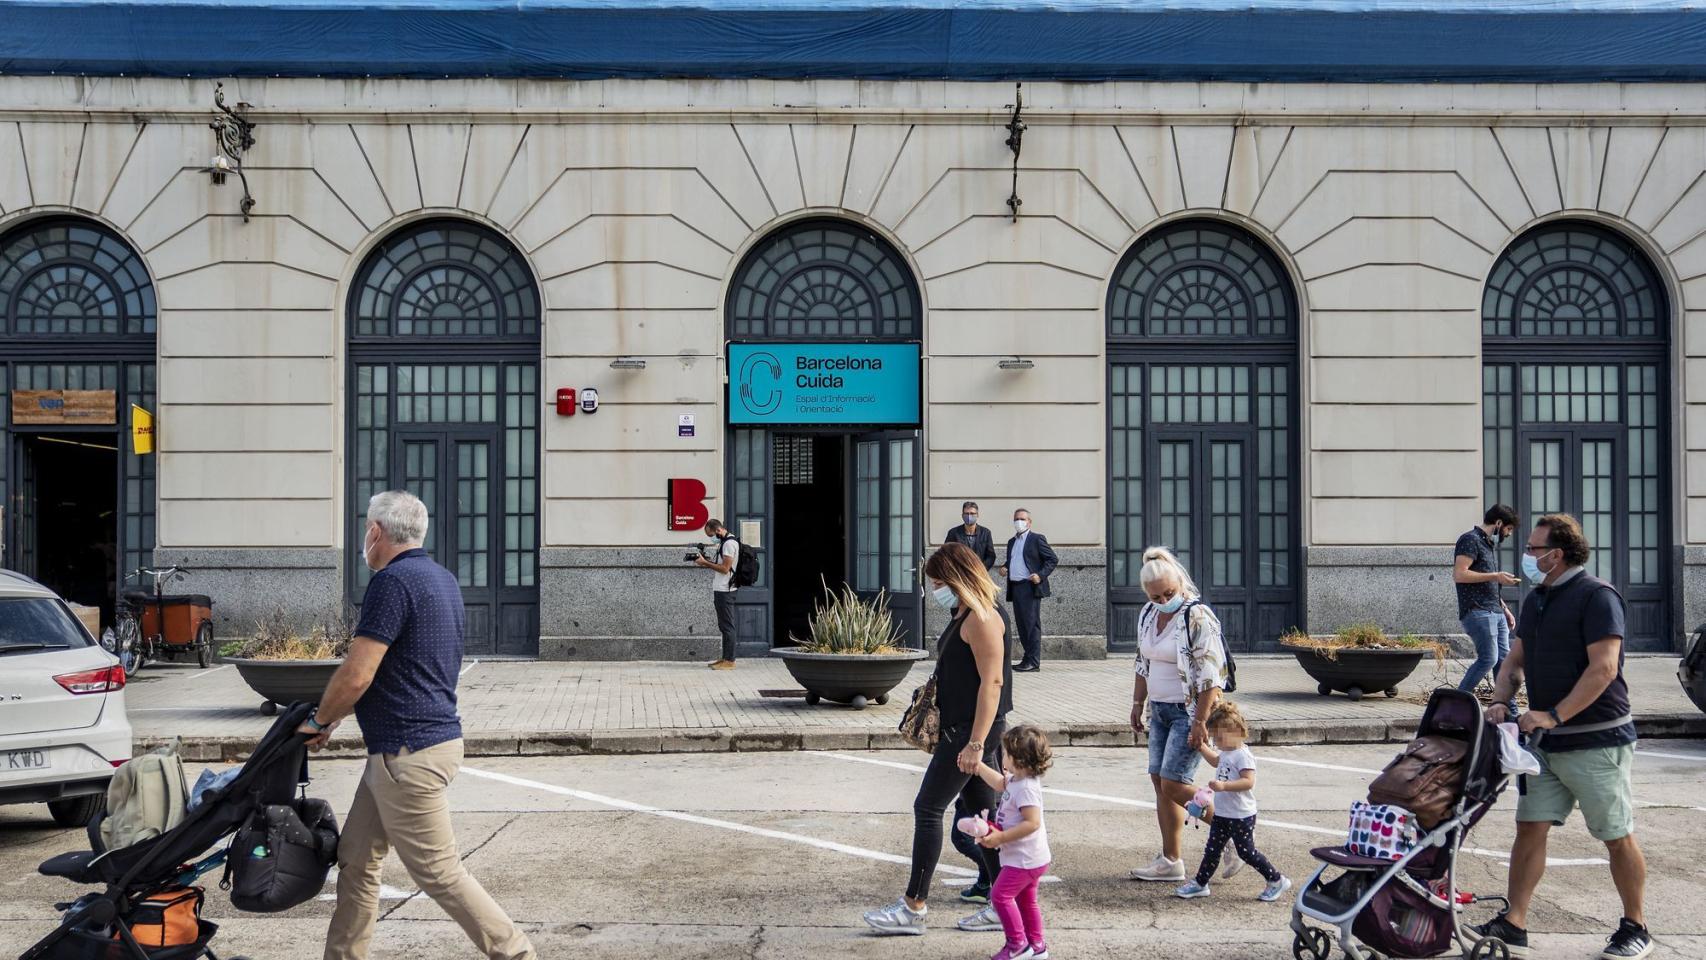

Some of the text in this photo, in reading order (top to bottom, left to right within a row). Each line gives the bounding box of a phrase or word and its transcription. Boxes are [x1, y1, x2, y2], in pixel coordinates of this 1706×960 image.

[796, 356, 882, 370] Barcelona
[796, 373, 843, 388] Cuida
[800, 405, 844, 413] Orientació
[8, 751, 44, 769] KWD
